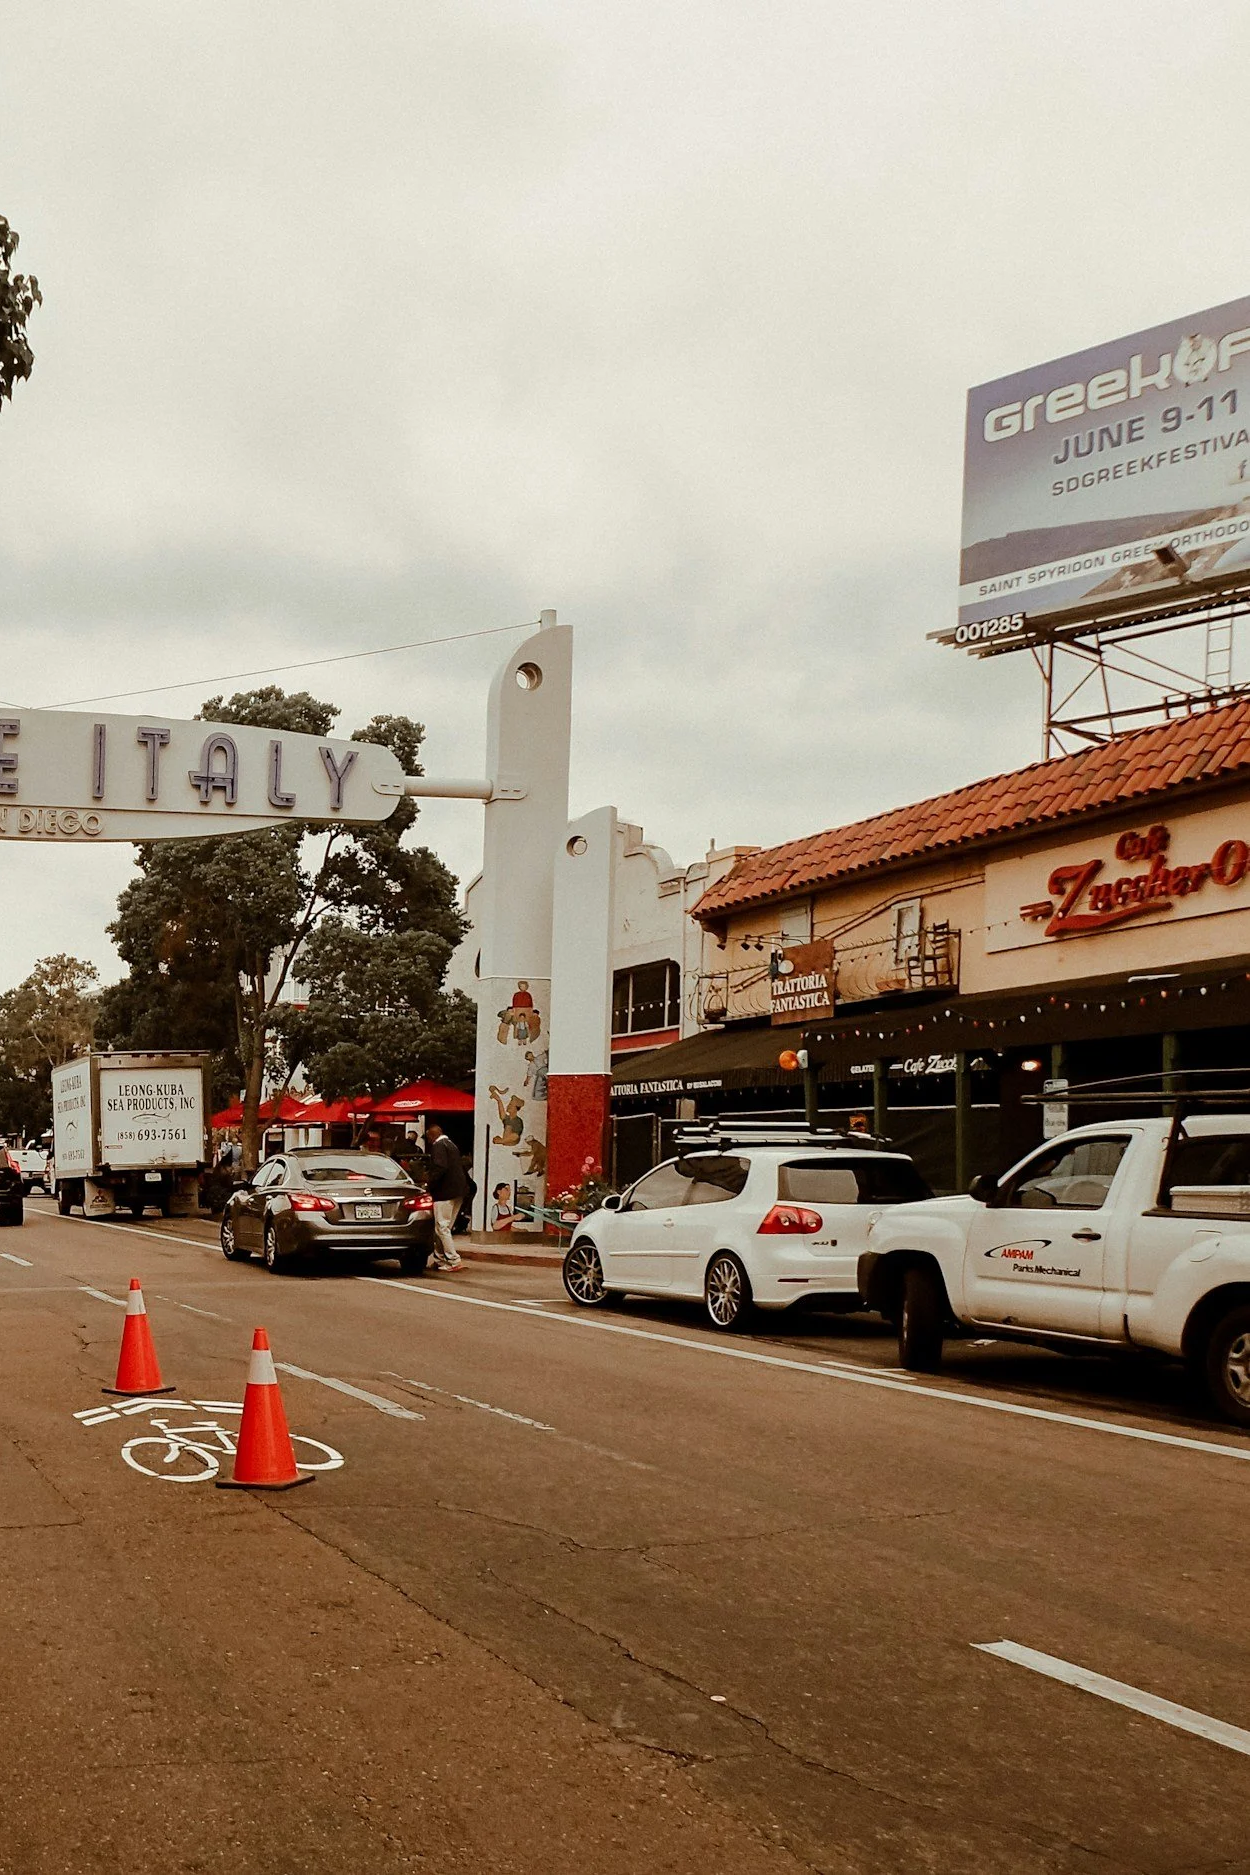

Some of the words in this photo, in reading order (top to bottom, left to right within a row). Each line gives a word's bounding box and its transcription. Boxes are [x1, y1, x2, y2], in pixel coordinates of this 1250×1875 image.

[1052, 415, 1145, 465] JUNE
[1160, 388, 1238, 434] 9-11
[978, 576, 1023, 597] SAINT
[1027, 557, 1105, 585] SPYRIDON
[1110, 540, 1165, 564] GREE
[955, 612, 1025, 644] 001285
[92, 723, 360, 810] ITALY
[17, 808, 104, 836] DIEGO
[771, 972, 828, 996] TRATTORIA
[770, 991, 831, 1014] FANTASTICA
[118, 1083, 185, 1097] LEONG-KUBA
[639, 1079, 684, 1094] FANTASTICA
[107, 1098, 125, 1112] SEA
[126, 1097, 178, 1112] PRODUCTS,
[180, 1096, 196, 1110] INC
[117, 1131, 136, 1141] (858)
[137, 1128, 188, 1141] 693-7561
[1000, 1248, 1035, 1261] AMPAM
[1012, 1263, 1034, 1274] Parks
[1034, 1265, 1082, 1277] Mechanical
